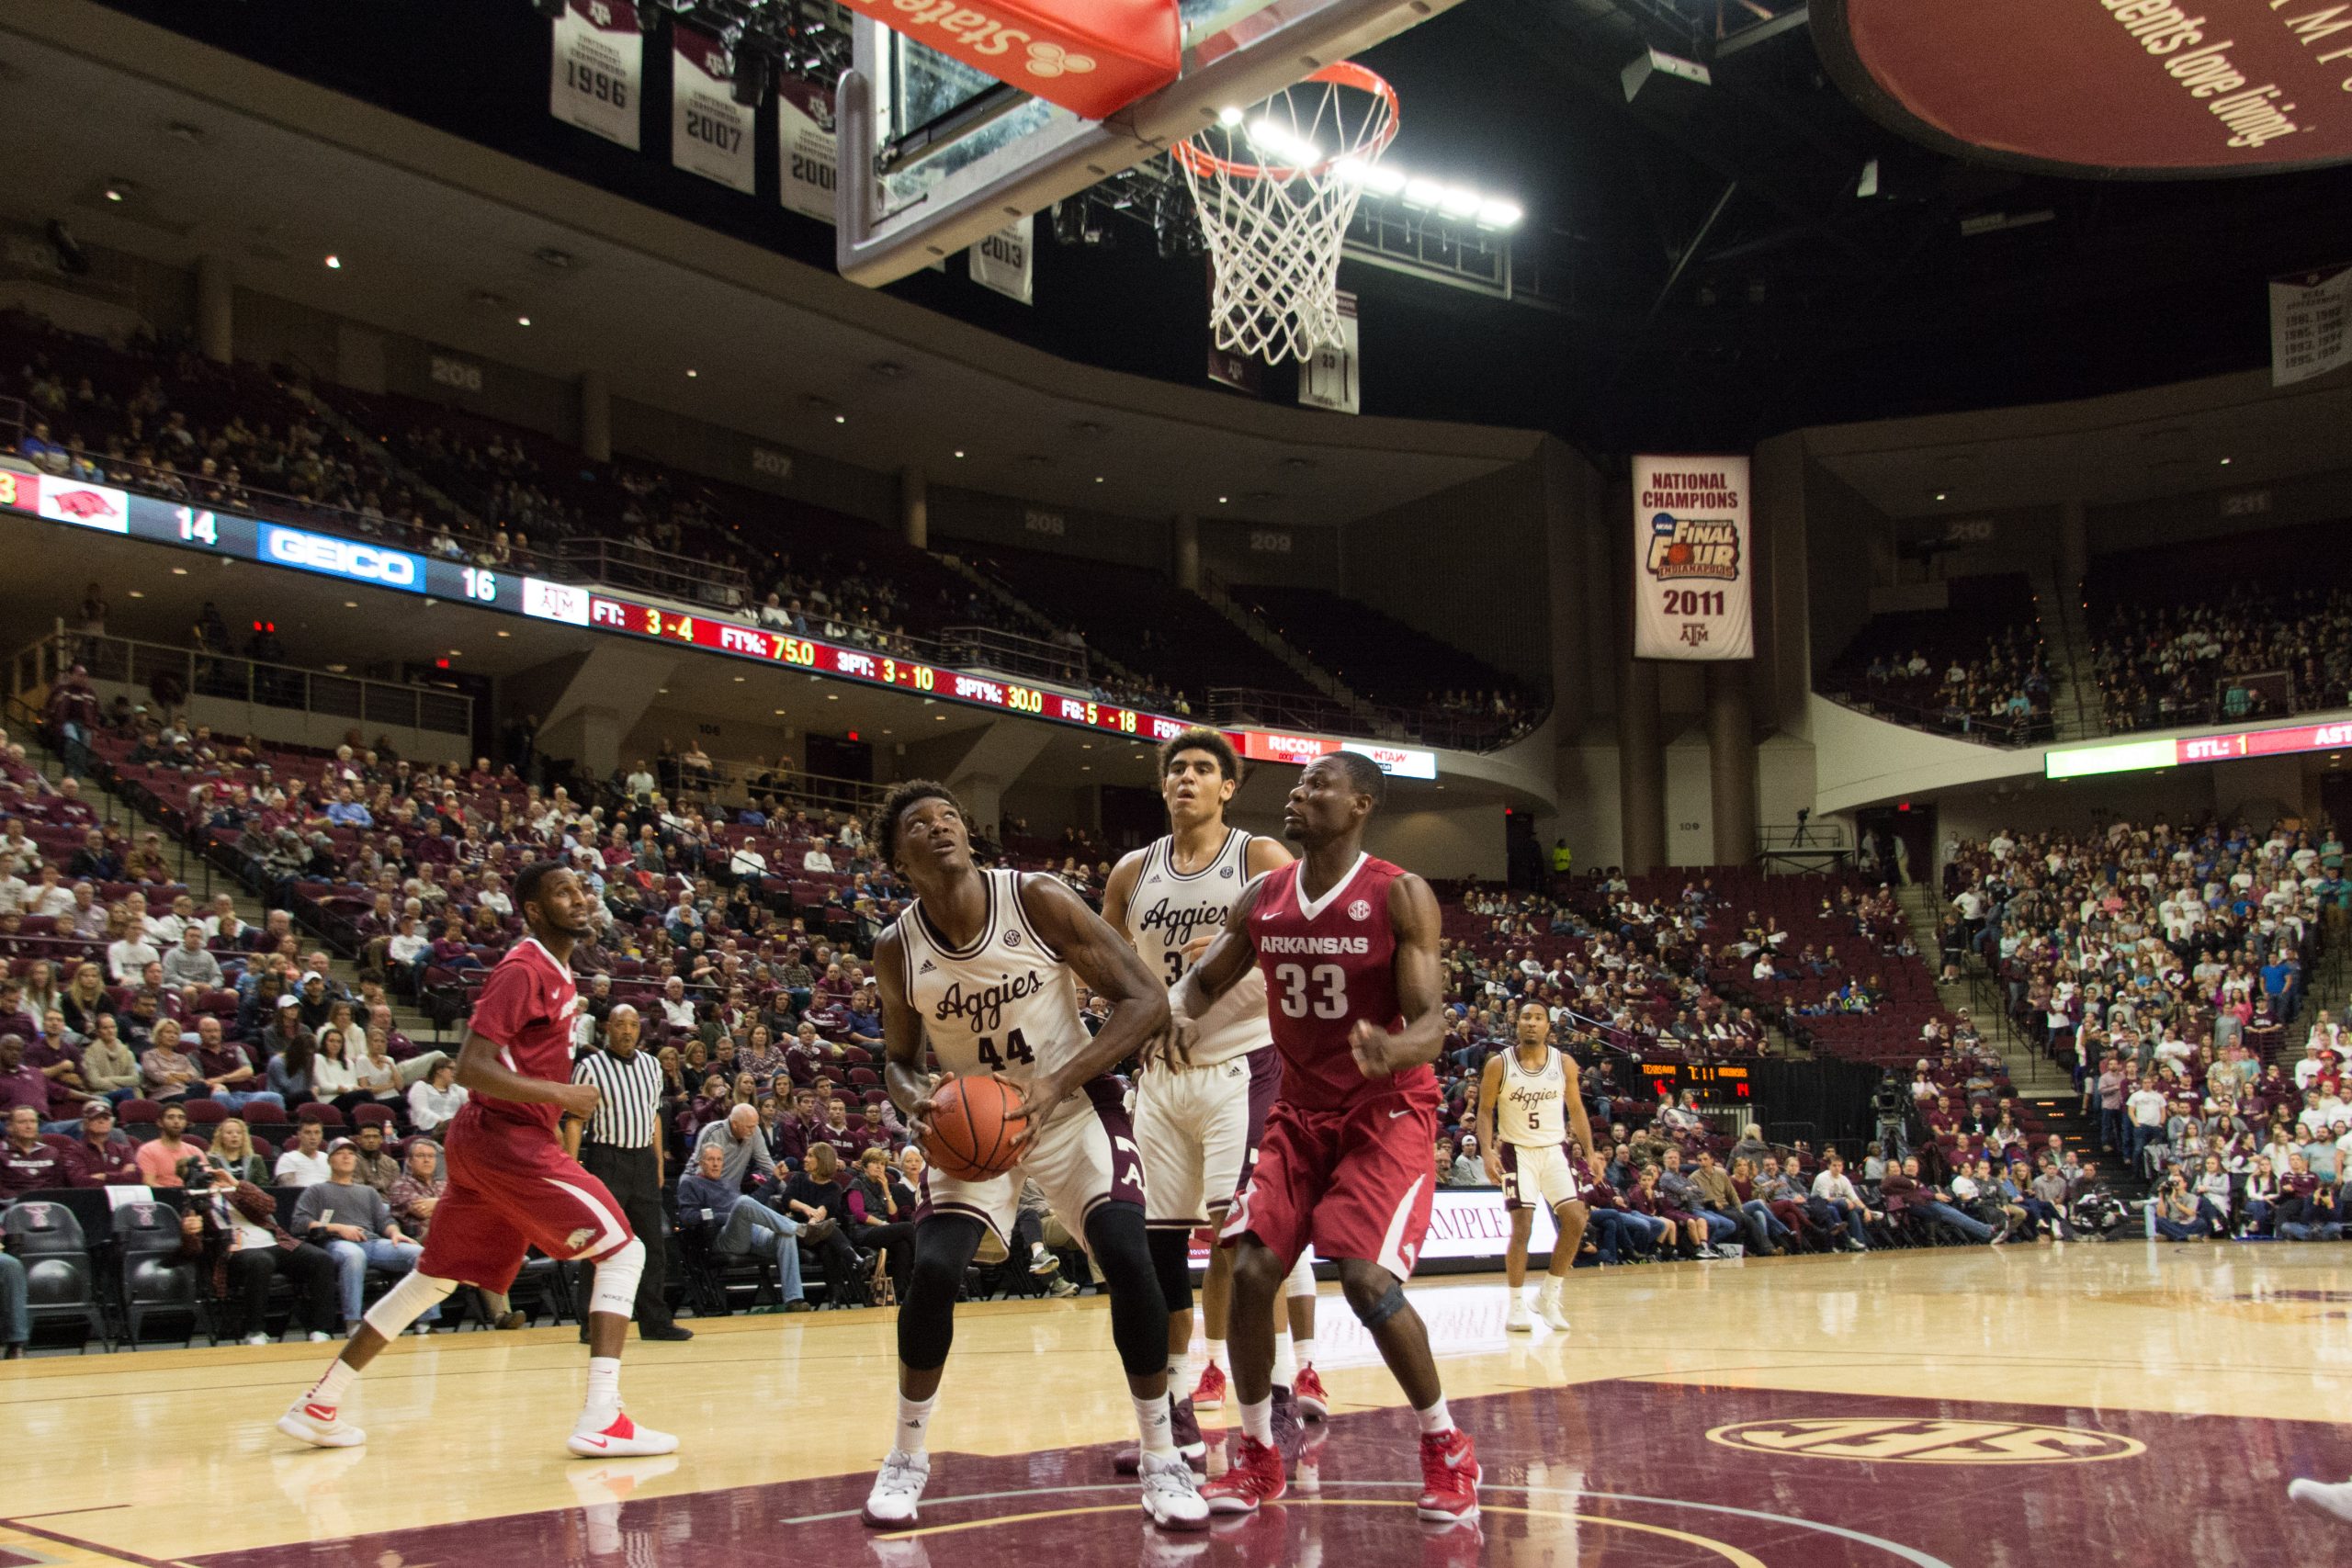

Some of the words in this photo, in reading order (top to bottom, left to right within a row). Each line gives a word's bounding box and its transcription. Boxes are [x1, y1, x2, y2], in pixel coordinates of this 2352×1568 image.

[567, 60, 627, 109] 1996
[2165, 39, 2233, 98] love
[687, 108, 742, 154] 2007
[792, 152, 836, 192] 200
[981, 234, 1023, 269] 2013
[1652, 473, 1727, 490] NATIONAL
[1643, 491, 1738, 509] CHAMPIONS
[175, 506, 218, 546] 14
[1672, 521, 1734, 544] FINAL
[270, 529, 415, 586] GEICO
[462, 567, 497, 602] 16
[1663, 590, 1724, 615] 2011
[593, 600, 625, 626] FT:
[721, 627, 767, 655] FT%:
[772, 636, 815, 666] 75.0
[837, 651, 875, 677] 3PT:
[955, 676, 1002, 704] 3PT%:
[1008, 686, 1043, 714] 30.0
[1061, 700, 1085, 720] FG:
[1118, 710, 1136, 733] 18
[1269, 736, 1321, 753] RICOH
[2187, 740, 2230, 759] STL:
[2236, 734, 2247, 755] 1
[1680, 823, 1700, 831] 109
[1140, 897, 1229, 946] Aggies
[1349, 901, 1370, 919] SEC
[1261, 936, 1369, 954] ARKANSAS
[1164, 951, 1194, 987] 3
[935, 970, 1044, 1033] Aggies
[1275, 963, 1349, 1019] 33
[978, 1027, 1035, 1072] 44
[1688, 1066, 1714, 1080] 7:11
[1510, 1086, 1558, 1111] Aggies
[1528, 1112, 1540, 1130] 5
